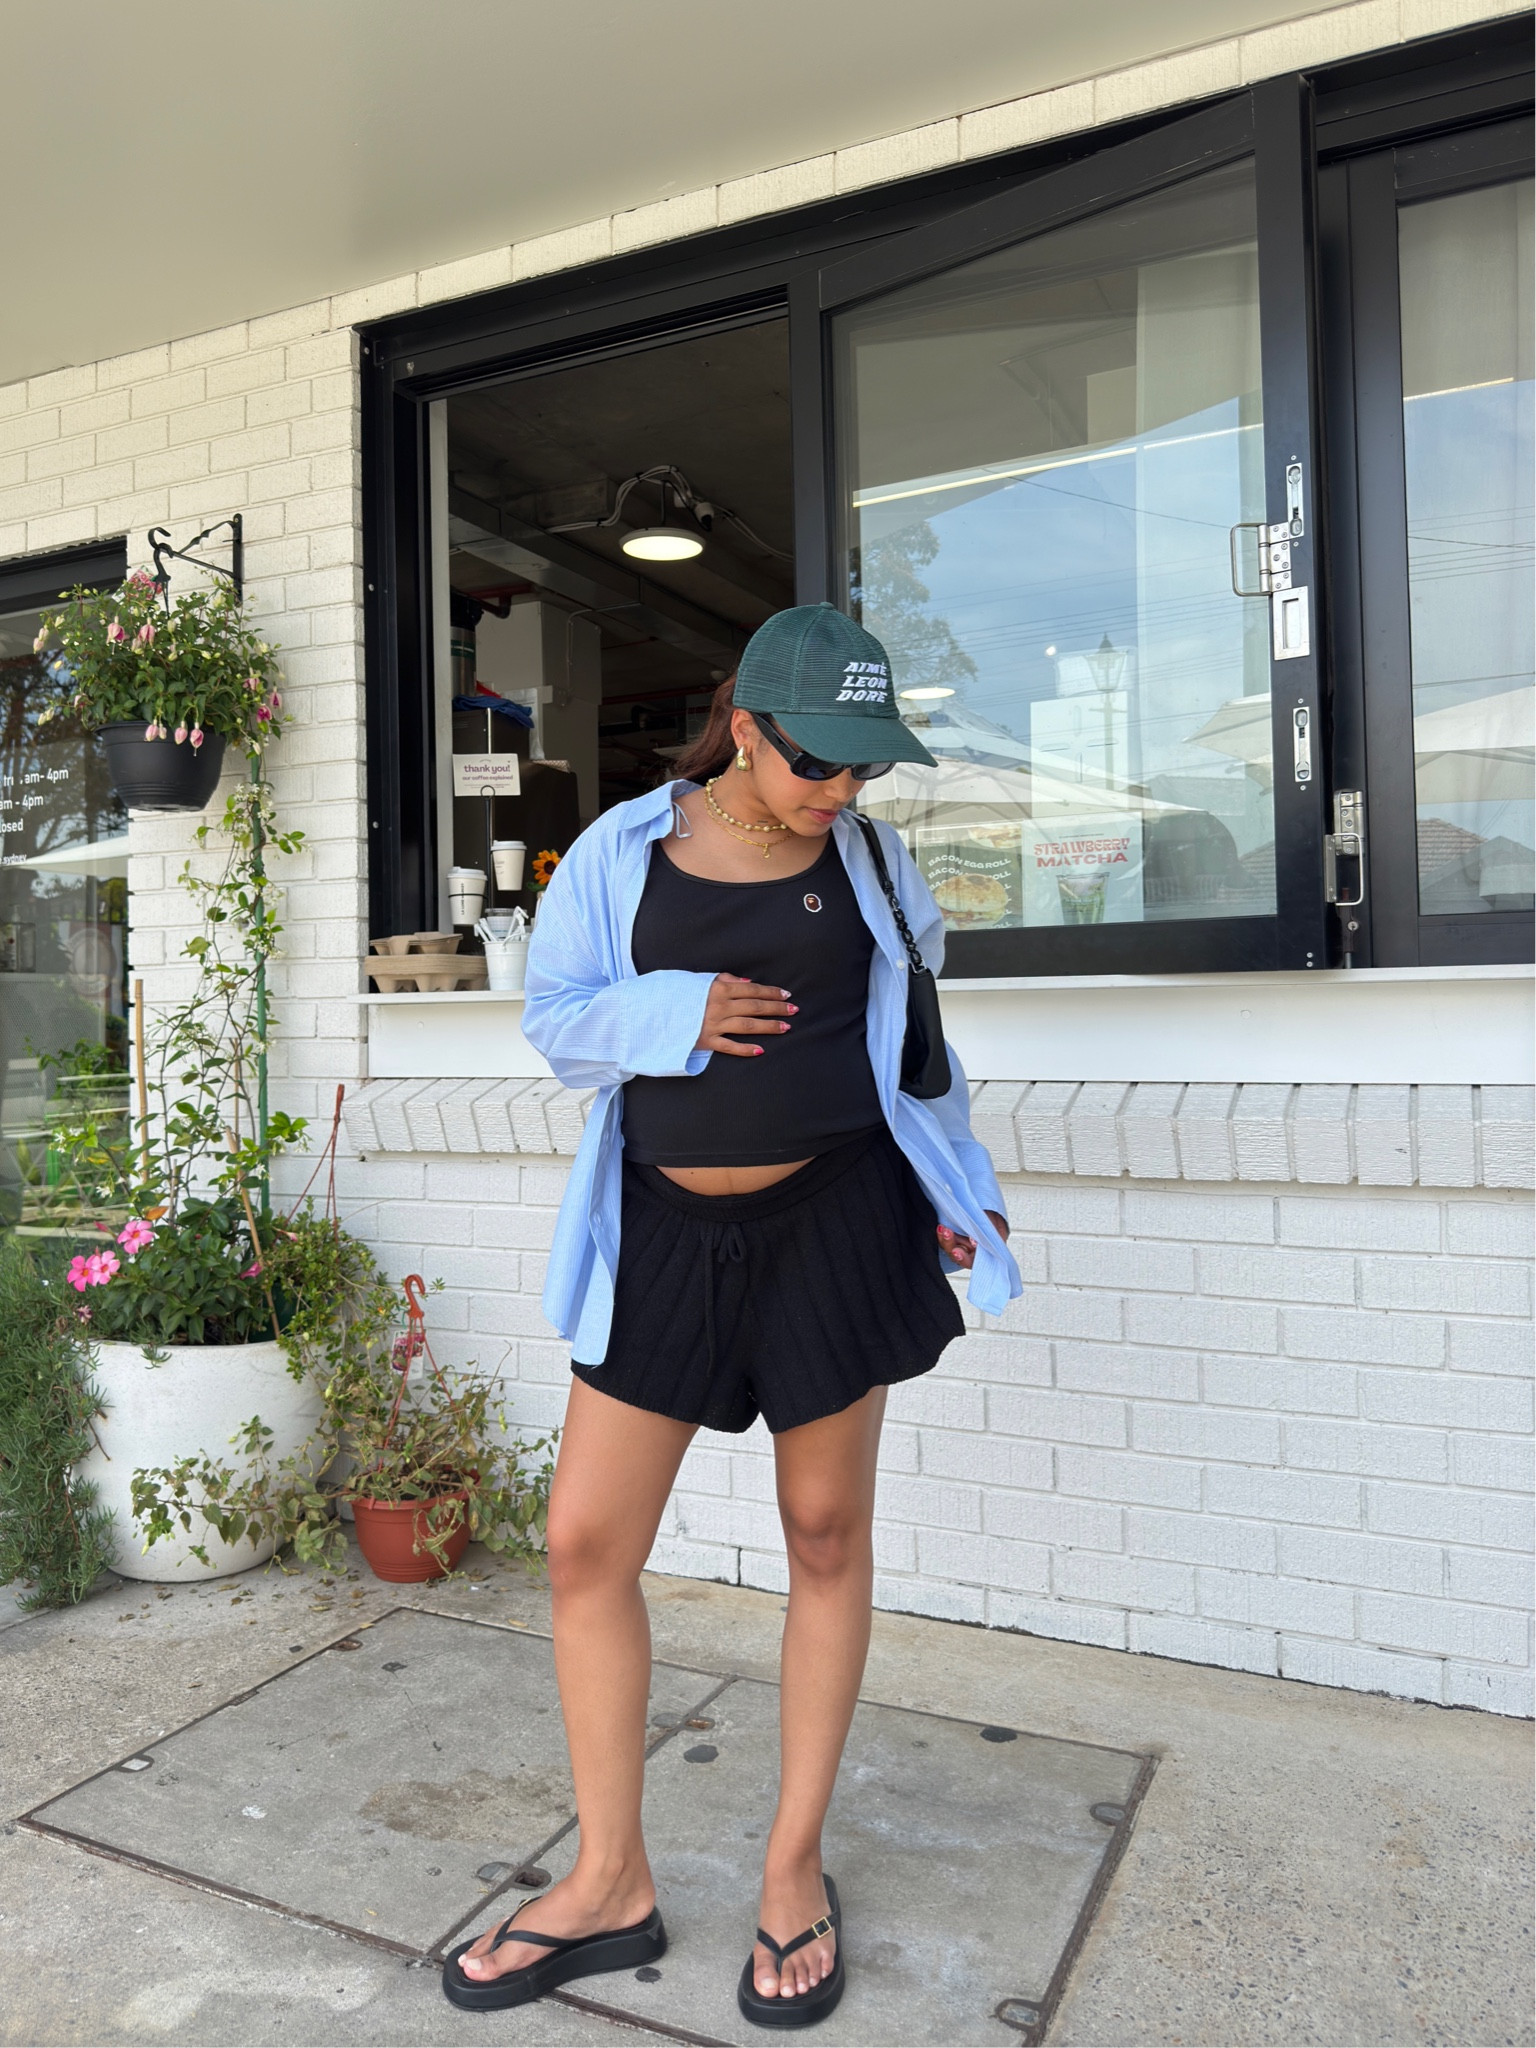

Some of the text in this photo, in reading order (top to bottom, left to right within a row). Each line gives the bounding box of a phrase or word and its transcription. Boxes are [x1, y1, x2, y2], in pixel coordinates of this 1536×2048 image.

[842, 675, 888, 689] LEON
[835, 689, 888, 703] DORE
[46, 767, 69, 784] 4pm
[463, 764, 511, 775] thank you!
[22, 794, 44, 811] 4pm
[1033, 838, 1130, 855] STRAWBERRY
[928, 855, 1012, 869] BACON EGG ROLL
[1036, 852, 1128, 868] MATCHA
[988, 870, 1012, 881] OLL
